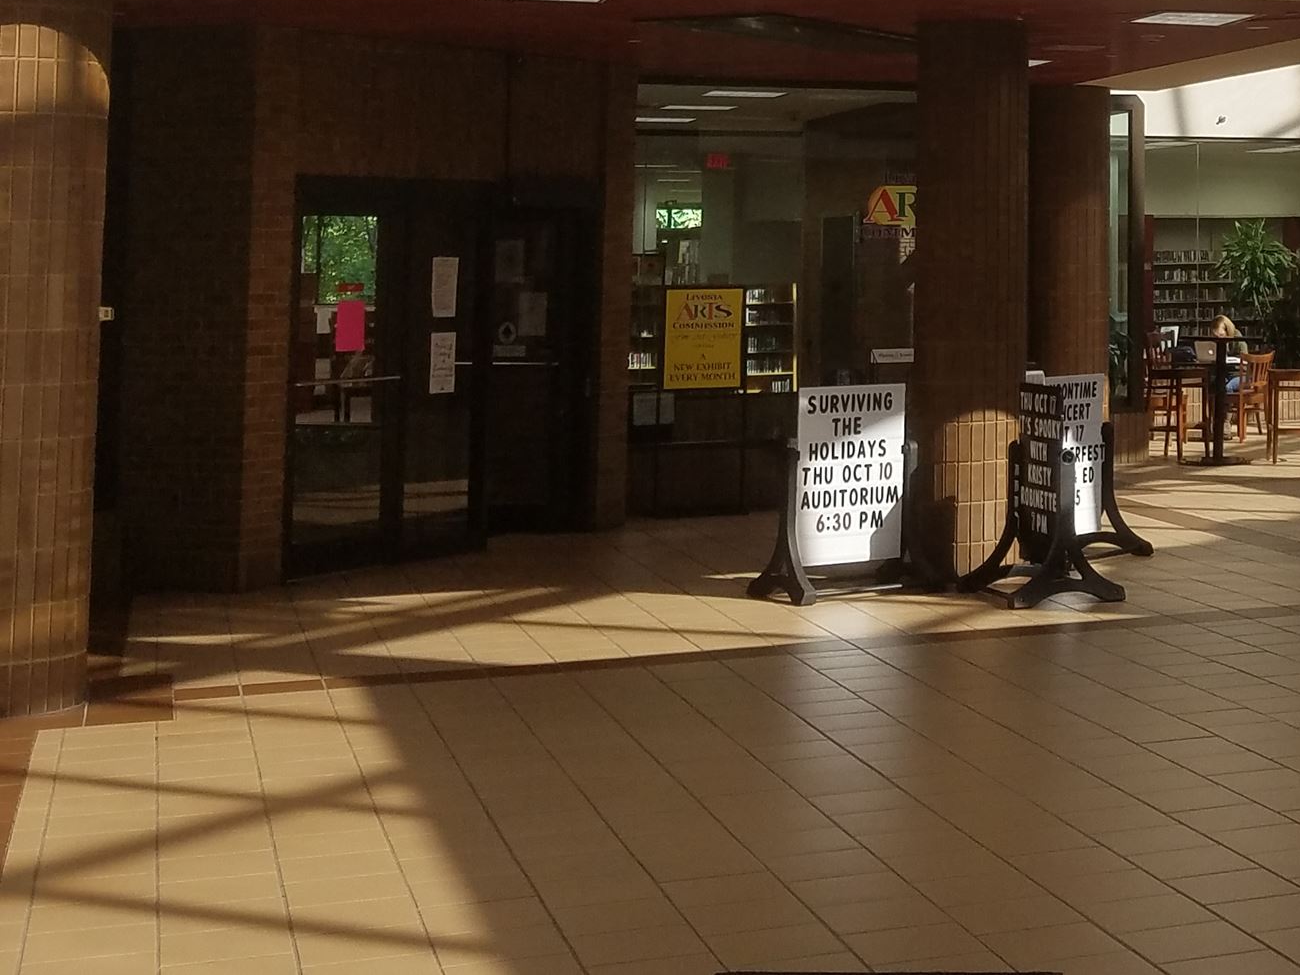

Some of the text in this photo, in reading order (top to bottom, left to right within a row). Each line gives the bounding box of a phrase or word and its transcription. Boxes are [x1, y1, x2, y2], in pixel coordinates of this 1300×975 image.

[676, 302, 733, 320] ARTS
[673, 321, 734, 329] COMMISSION
[669, 372, 736, 382] EVERY MONTH
[674, 362, 732, 371] NEW EXHIBIT
[807, 392, 893, 414] SURVIVING
[1020, 391, 1057, 415] THU OCT 17
[832, 416, 862, 437] THE
[1019, 415, 1061, 440] IT'S SPOOKY
[1075, 425, 1085, 442] 17
[809, 439, 886, 462] HOLIDAYS
[1030, 440, 1049, 463] WITH
[802, 462, 893, 486] THU OCT 10
[1028, 463, 1052, 487] KRISTY
[800, 485, 899, 511] AUDITORIUM
[1020, 485, 1057, 513] ROBINETTE
[816, 510, 884, 533] 6:30 PM
[1036, 513, 1048, 535] PM
